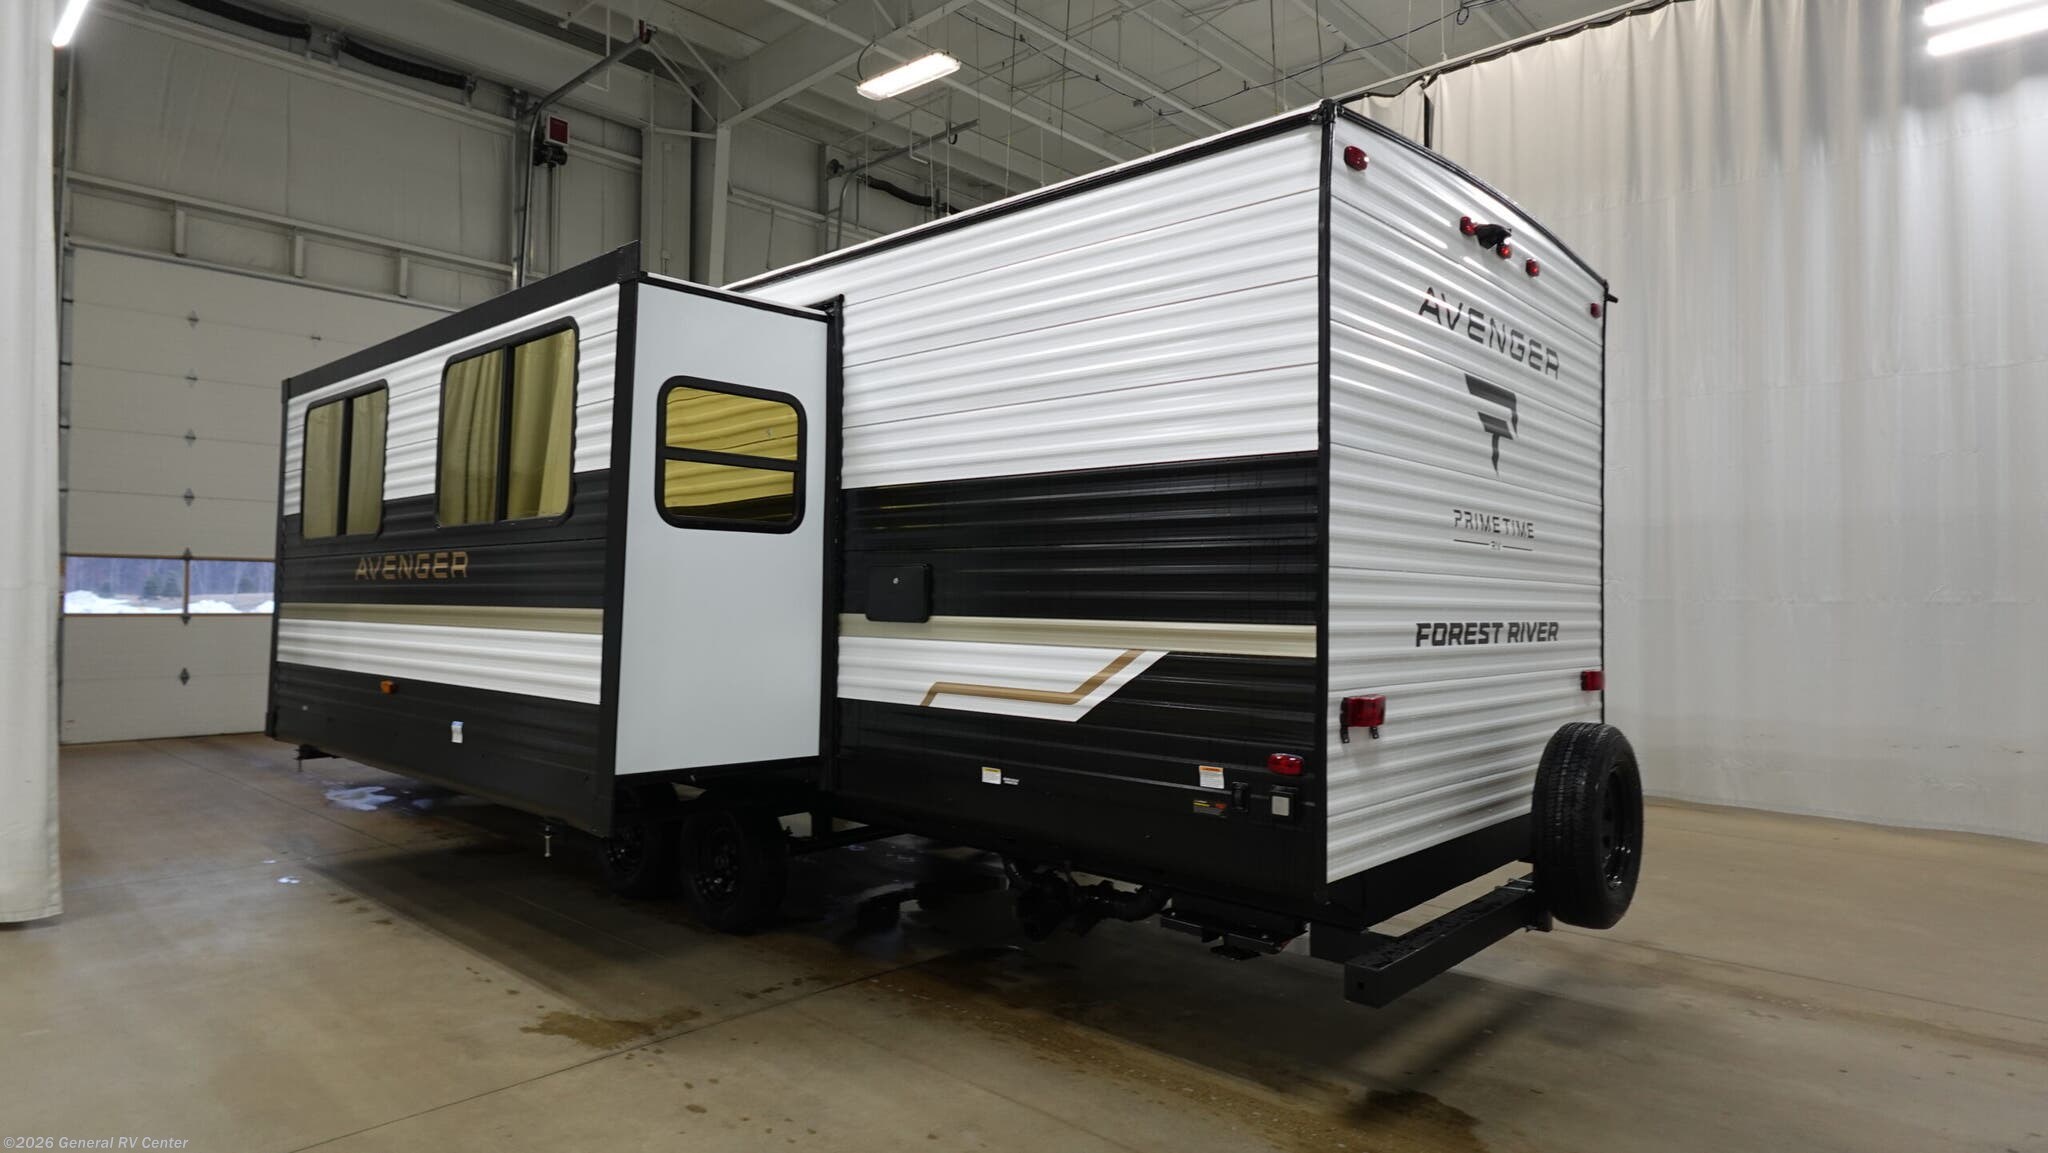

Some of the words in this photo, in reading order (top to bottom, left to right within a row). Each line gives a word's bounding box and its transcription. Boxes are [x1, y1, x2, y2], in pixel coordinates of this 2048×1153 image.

[1418, 286, 1560, 380] AVENGER
[354, 551, 469, 580] AVENGER
[1415, 622, 1504, 647] FOREST
[1507, 622, 1560, 644] RIVER
